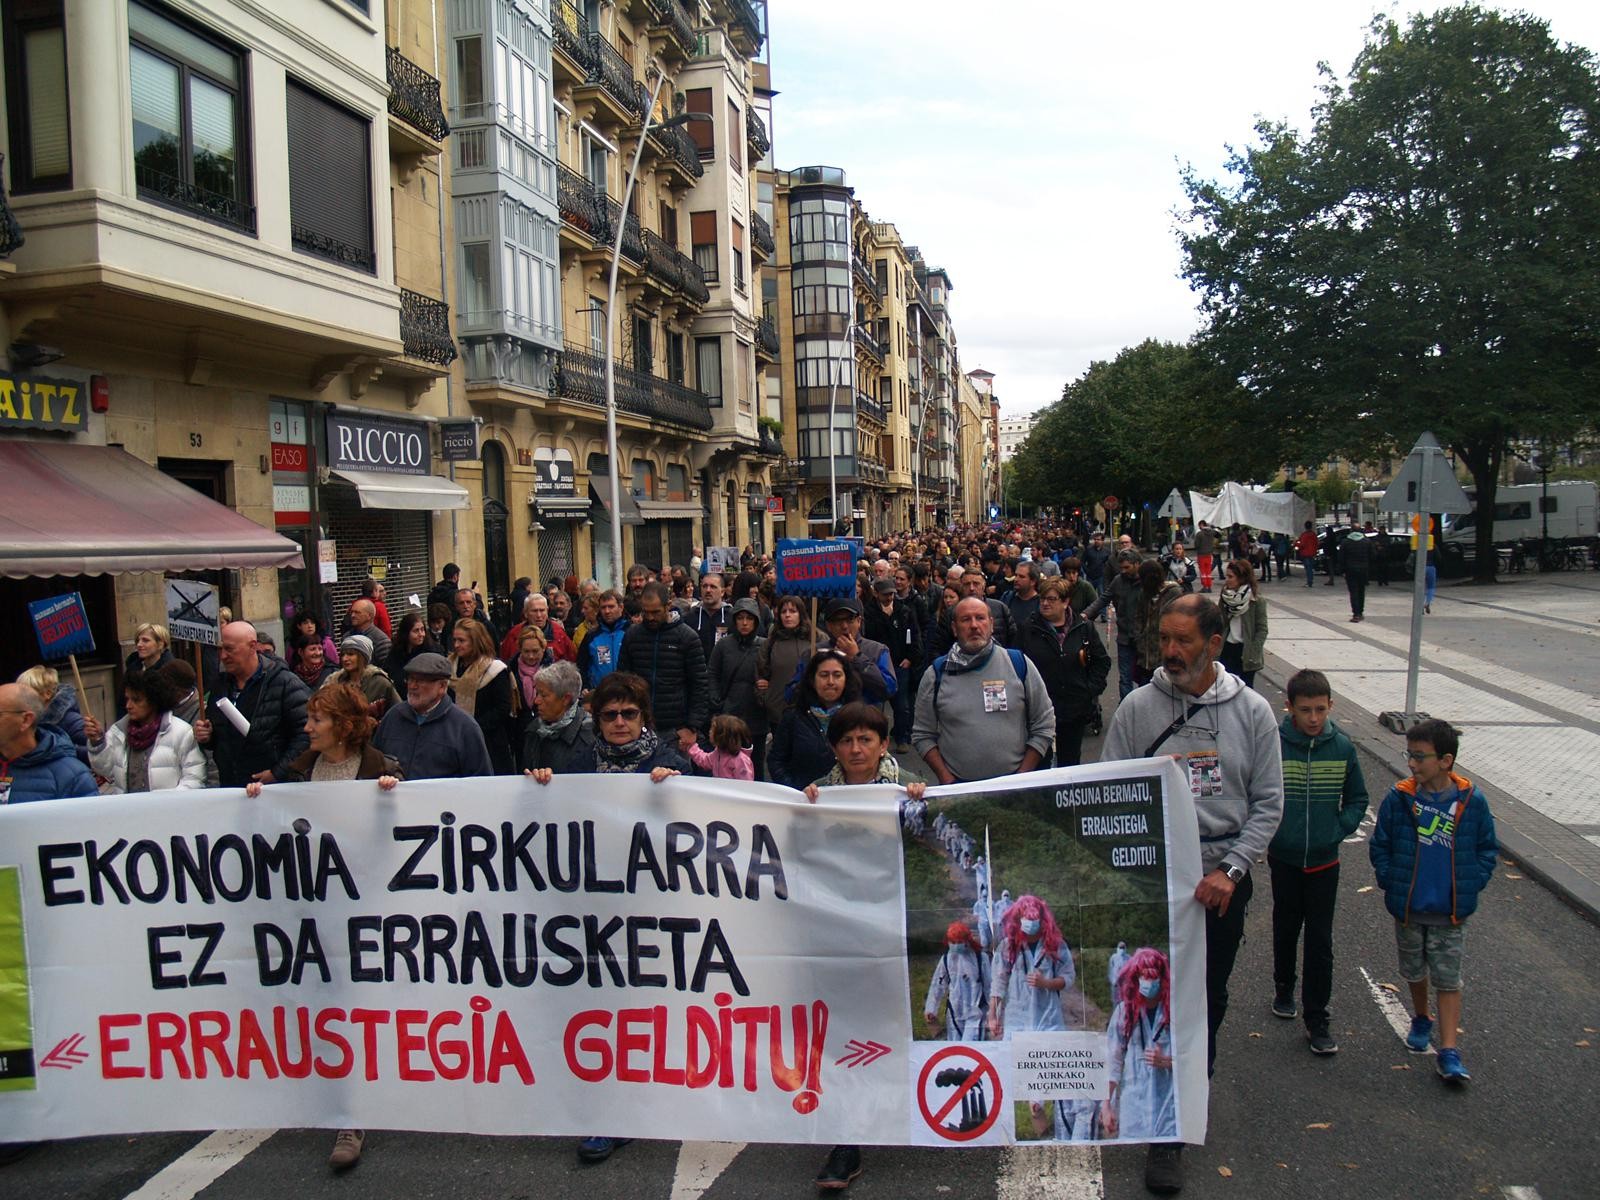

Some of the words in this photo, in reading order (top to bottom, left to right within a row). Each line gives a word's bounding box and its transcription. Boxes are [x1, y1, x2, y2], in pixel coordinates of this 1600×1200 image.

[190, 432, 202, 448] 53
[337, 425, 422, 467] RICCIO
[444, 435, 473, 448] riccio
[274, 448, 302, 466] EASO
[781, 547, 814, 557] osasuna
[815, 543, 849, 553] bermatu
[1055, 786, 1102, 808] OSASUNA
[1103, 782, 1152, 805] BERMATU,
[1081, 814, 1148, 836] ERRAUSTEGIA
[1112, 846, 1157, 867] GELDITU!
[147, 921, 227, 989] EZ
[253, 918, 331, 986] DA
[348, 910, 751, 996] ERRAUSKETA
[1028, 1050, 1093, 1058] GIPUZKOAKO
[1017, 1061, 1105, 1069] ERRAUSTEGIAREN
[1037, 1071, 1085, 1079] AURKAKO
[1028, 1082, 1095, 1090] MUGIMENDUA
